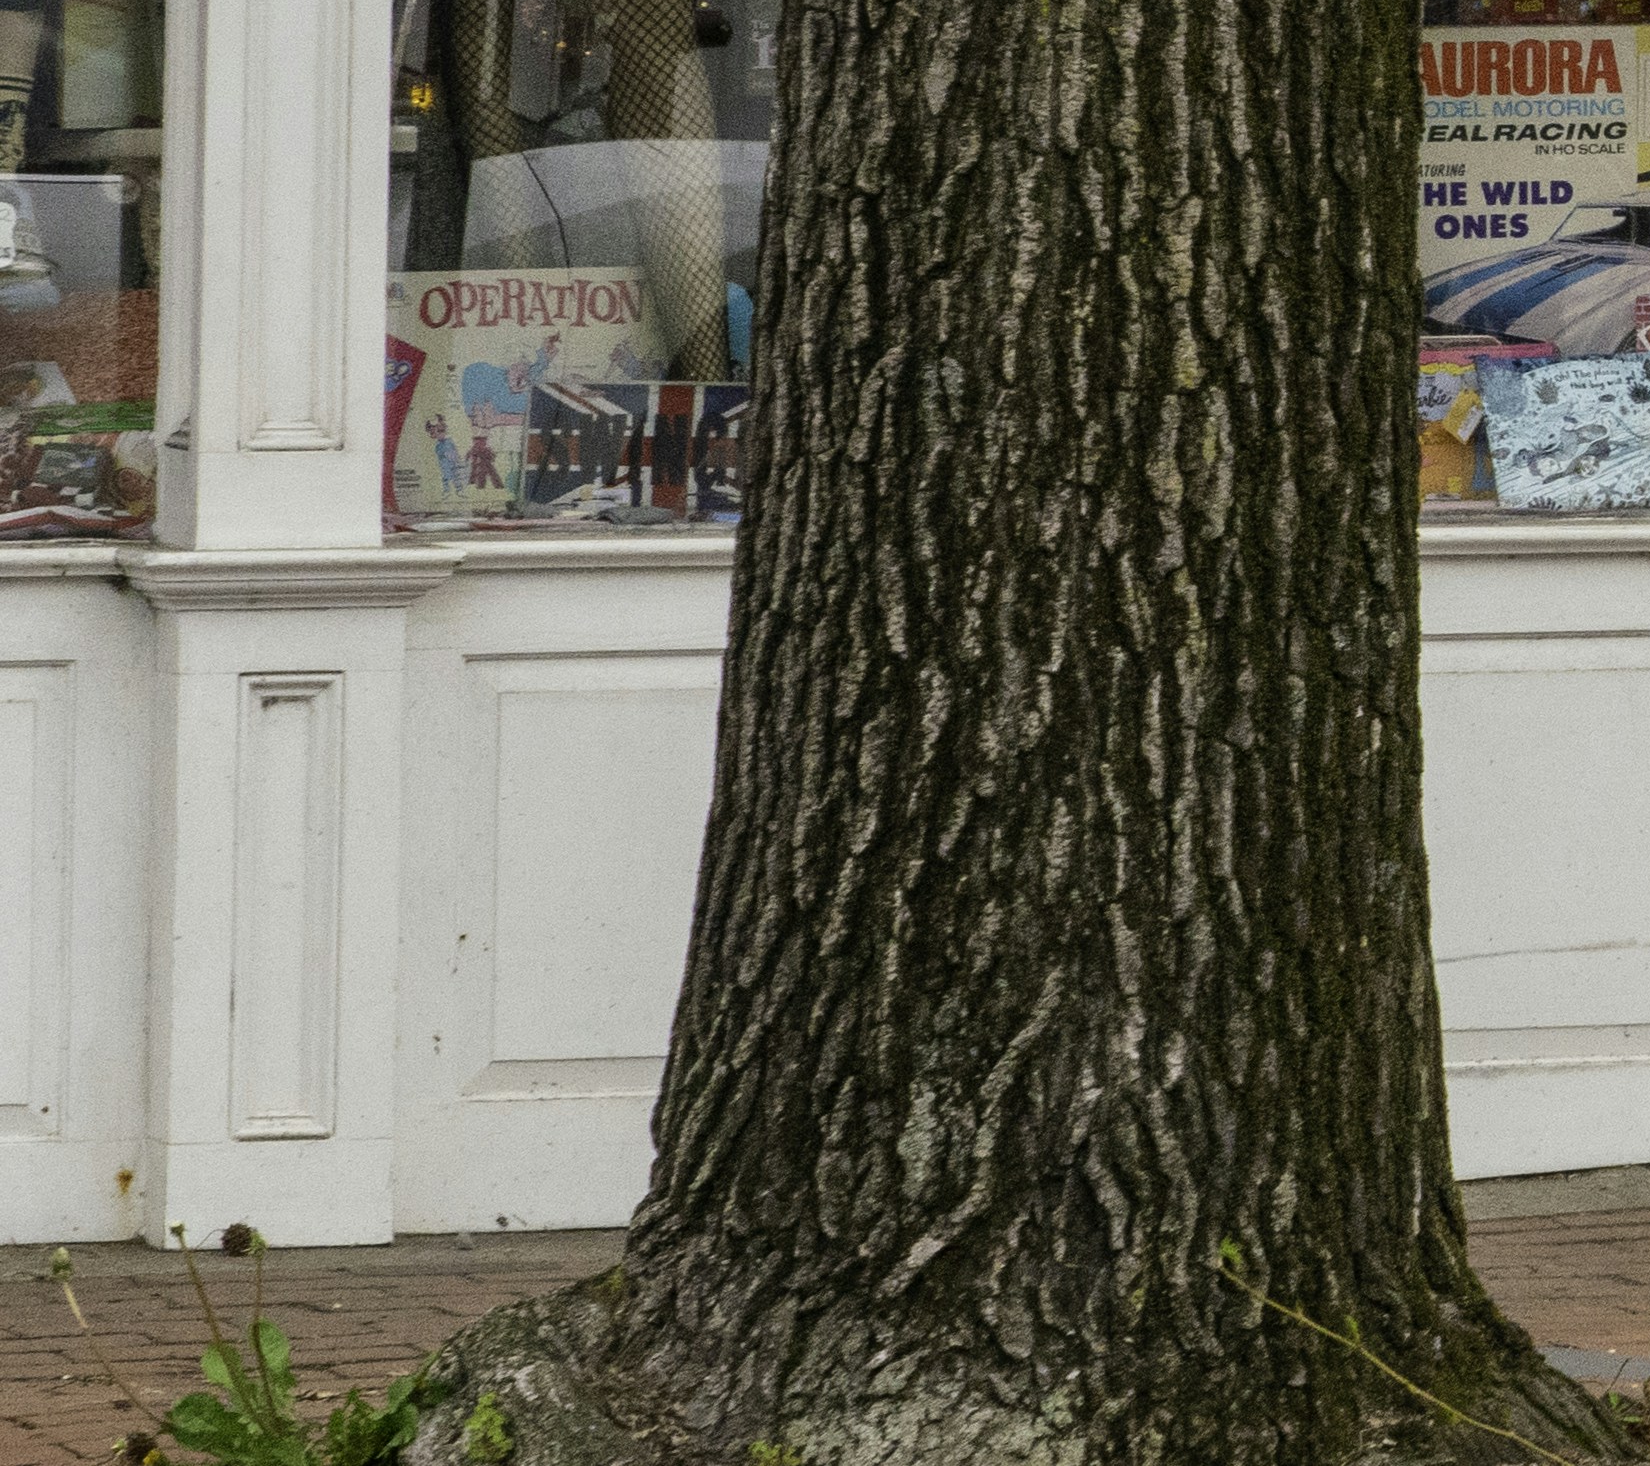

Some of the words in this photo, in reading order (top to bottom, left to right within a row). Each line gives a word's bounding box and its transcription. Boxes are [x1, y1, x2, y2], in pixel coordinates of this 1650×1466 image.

[1418, 38, 1623, 97] AURORA
[1423, 101, 1487, 118] ODEL
[1491, 98, 1626, 118] MOTORING
[1422, 123, 1490, 144] EAL
[1496, 121, 1629, 142] RACING
[1534, 145, 1551, 156] IN
[1577, 142, 1626, 155] SCALE
[1422, 181, 1469, 207] HE
[1482, 180, 1575, 205] WILD
[1434, 214, 1530, 240] ONES
[419, 278, 641, 329] OPERATION
